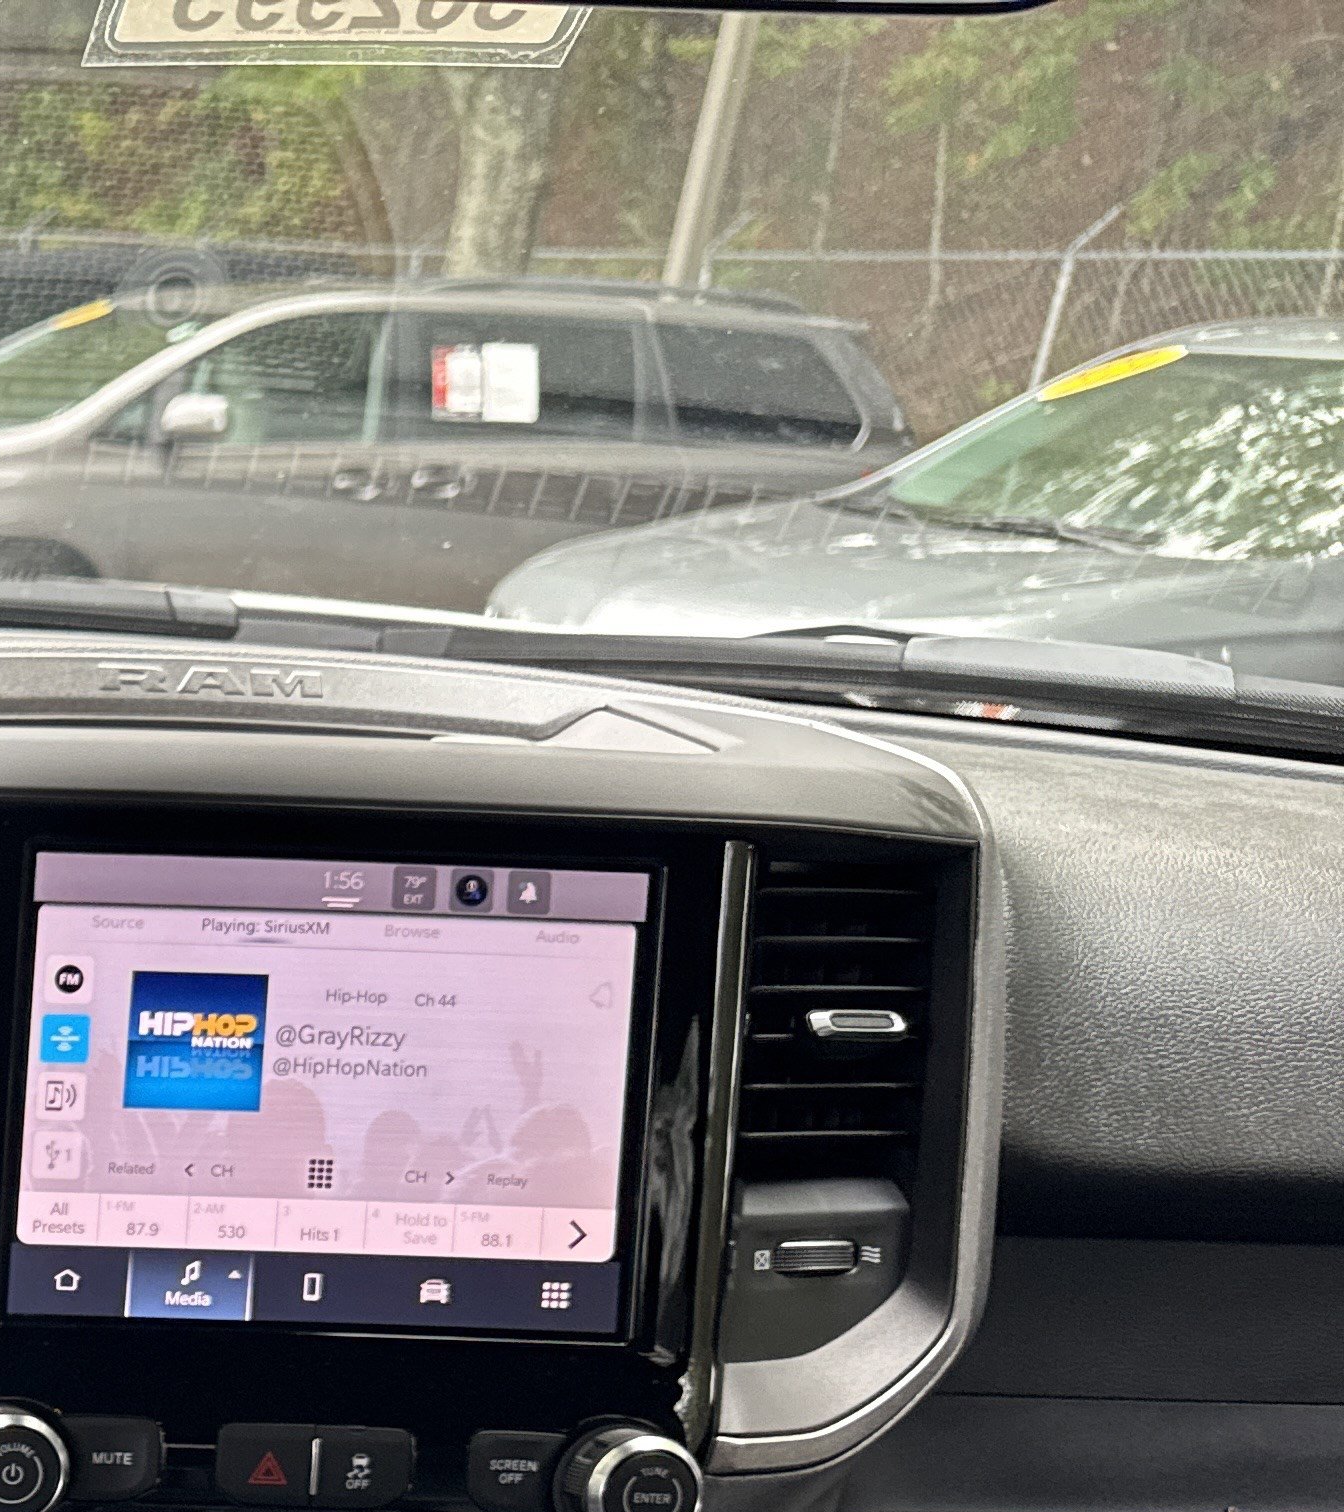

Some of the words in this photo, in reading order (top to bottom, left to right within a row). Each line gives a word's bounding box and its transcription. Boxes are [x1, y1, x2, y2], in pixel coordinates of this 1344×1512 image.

[97, 661, 324, 699] RAM
[323, 871, 365, 890] 1:56
[91, 915, 145, 930] Source
[201, 918, 260, 935] Playing:
[264, 920, 331, 935] SiriusXM
[384, 925, 441, 940] Browse
[535, 929, 580, 945] Audio
[58, 973, 81, 986] FM
[325, 989, 390, 1007] Hip-Hop
[414, 993, 436, 1008] Ch
[437, 994, 458, 1008] 44
[190, 1035, 253, 1050] NATION
[275, 1024, 407, 1051] @GrayRizzy
[272, 1056, 428, 1079] @HipHopNation
[107, 1162, 155, 1176] Related
[210, 1165, 235, 1178] CH
[404, 1171, 428, 1184] CH
[487, 1173, 529, 1190] Replay
[50, 1202, 69, 1216] All
[106, 1201, 136, 1213] 1-FM
[193, 1202, 226, 1214] 2-AM
[395, 1212, 431, 1227] Hold
[433, 1214, 448, 1228] to
[31, 1220, 86, 1236] Presets
[125, 1222, 161, 1238] 87.9
[217, 1225, 246, 1239] 530
[299, 1227, 331, 1242] Hits
[332, 1228, 340, 1242] 1
[403, 1231, 438, 1246] Save
[480, 1233, 514, 1248] 88.1
[164, 1290, 213, 1308] Media
[92, 1451, 134, 1466] MUTE
[489, 1459, 539, 1473] SCREEN
[345, 1479, 372, 1491] OFF
[499, 1473, 525, 1485] OFF
[633, 1492, 673, 1505] ENTER
